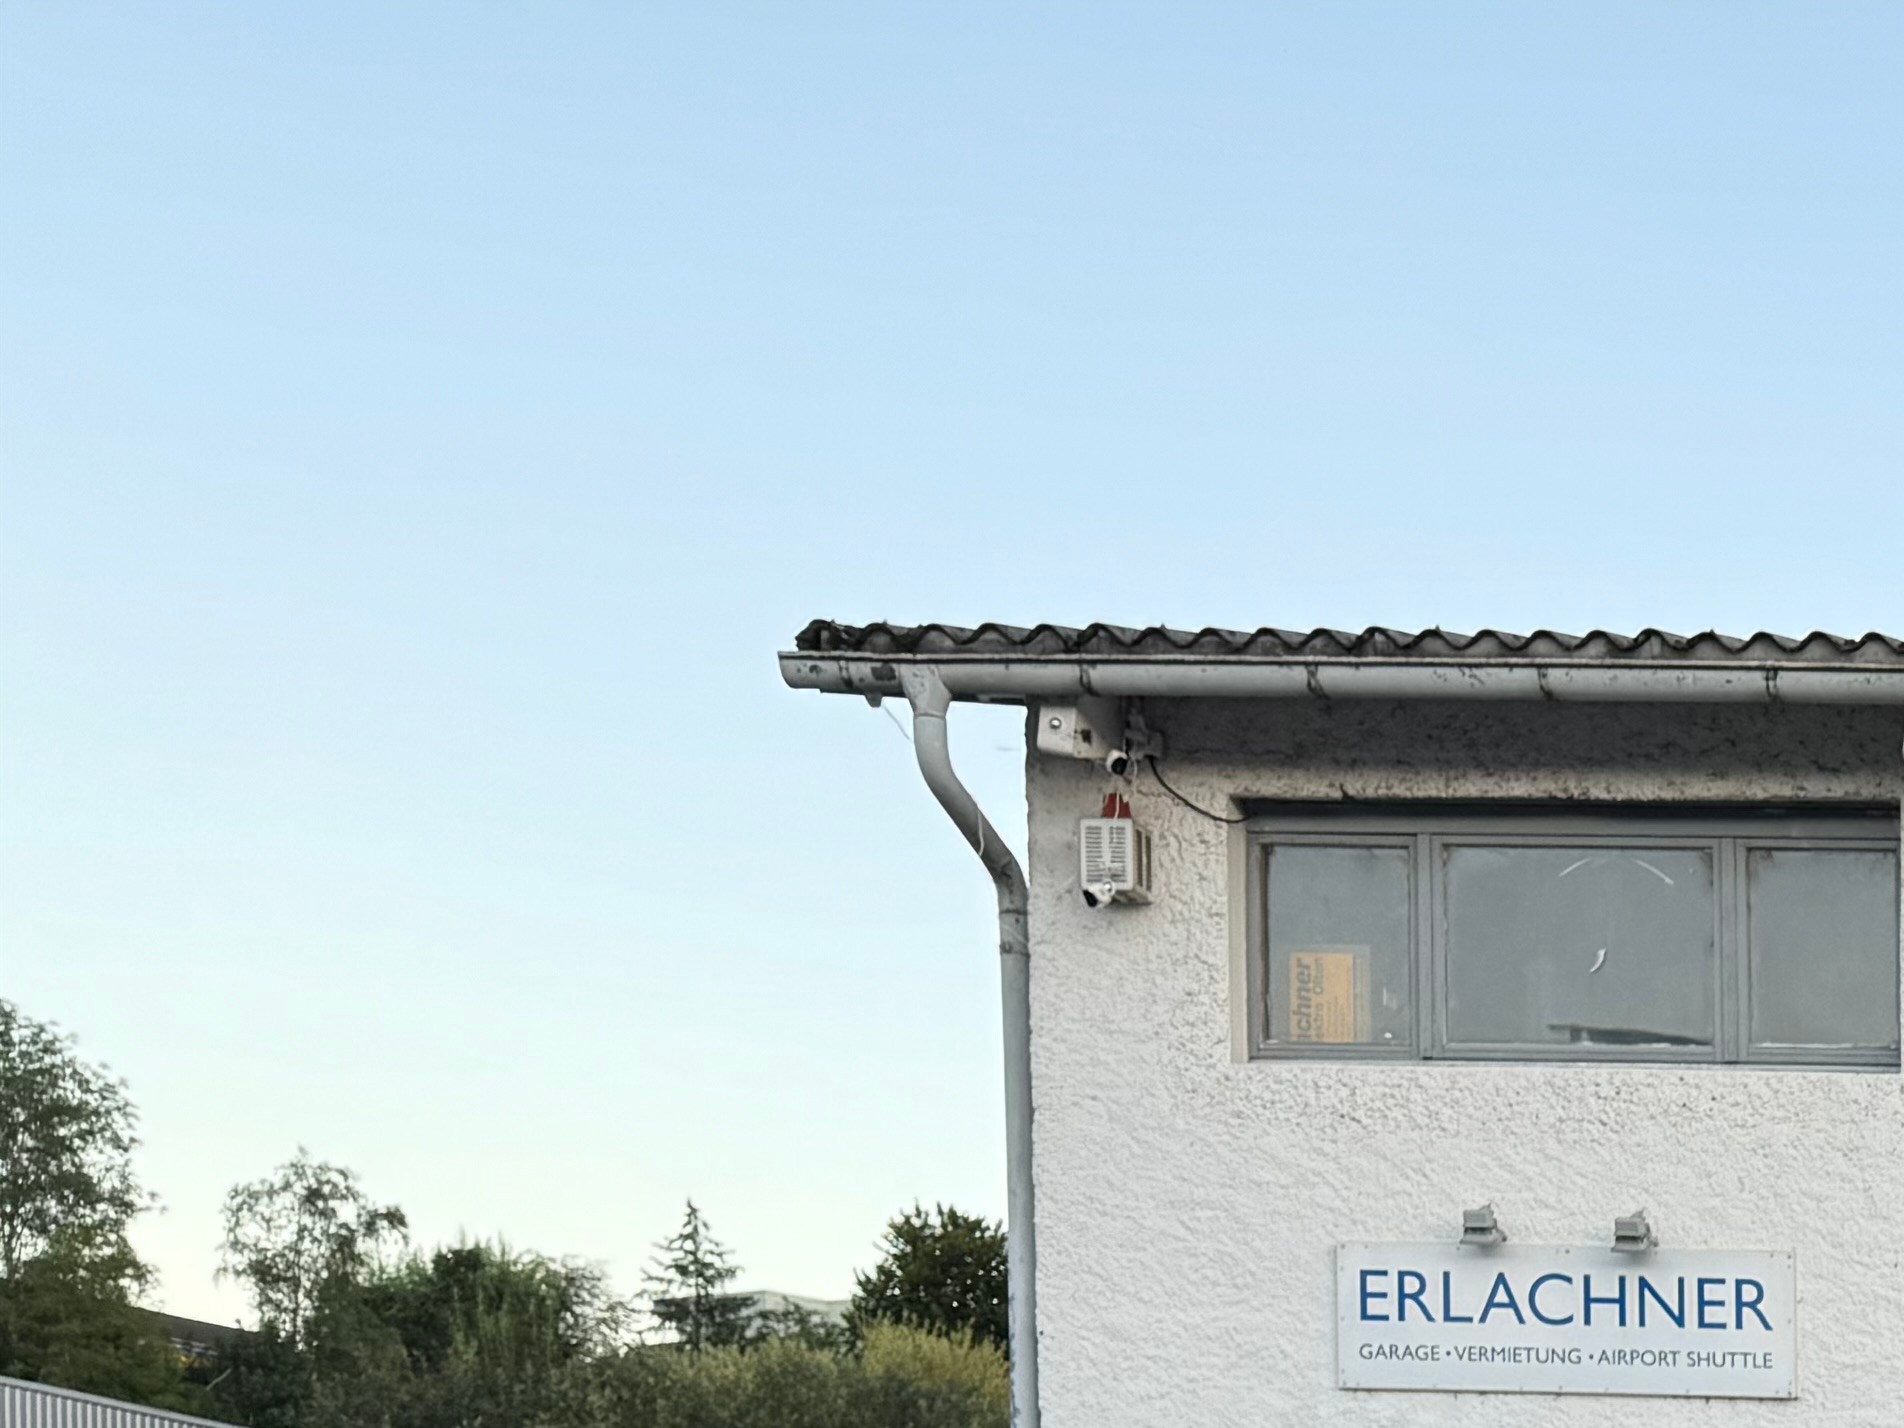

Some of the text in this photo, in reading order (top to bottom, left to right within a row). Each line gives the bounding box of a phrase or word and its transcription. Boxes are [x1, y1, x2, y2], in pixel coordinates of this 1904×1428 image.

[1358, 1269, 1773, 1331] ERLACHNER
[1358, 1343, 1773, 1370] GARAGE VERMIETUNG AIRPORT SHUTTLE
